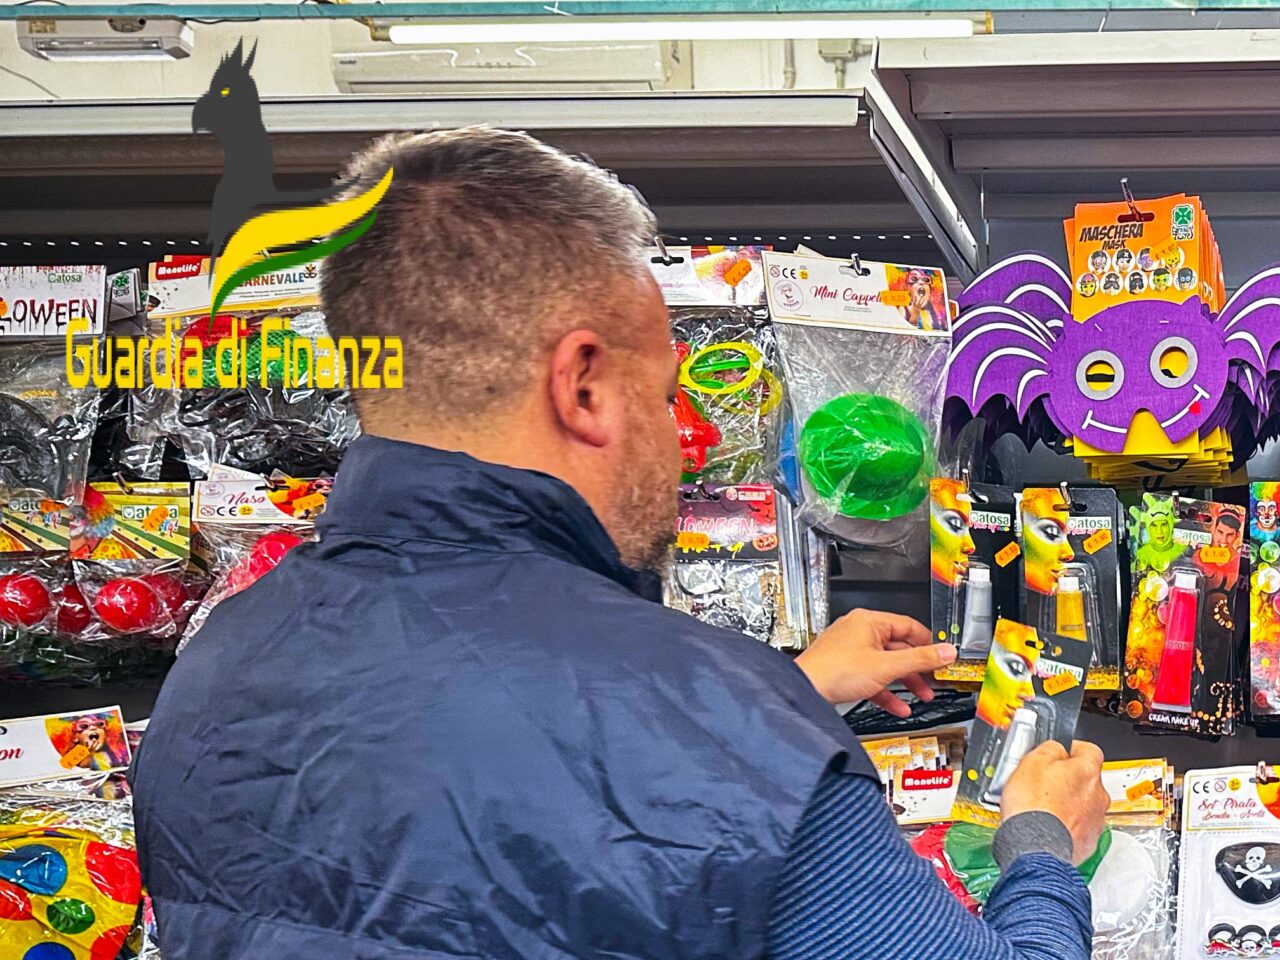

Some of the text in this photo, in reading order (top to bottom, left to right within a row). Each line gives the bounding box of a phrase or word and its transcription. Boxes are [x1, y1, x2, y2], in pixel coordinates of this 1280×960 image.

[1079, 222, 1144, 243] MASCHERA
[1101, 239, 1127, 251] MASK
[810, 285, 838, 300] Mini
[0, 298, 98, 327] OWEEN
[225, 490, 267, 506] Naso
[136, 505, 178, 519] ata
[1223, 797, 1257, 809] Pirata
